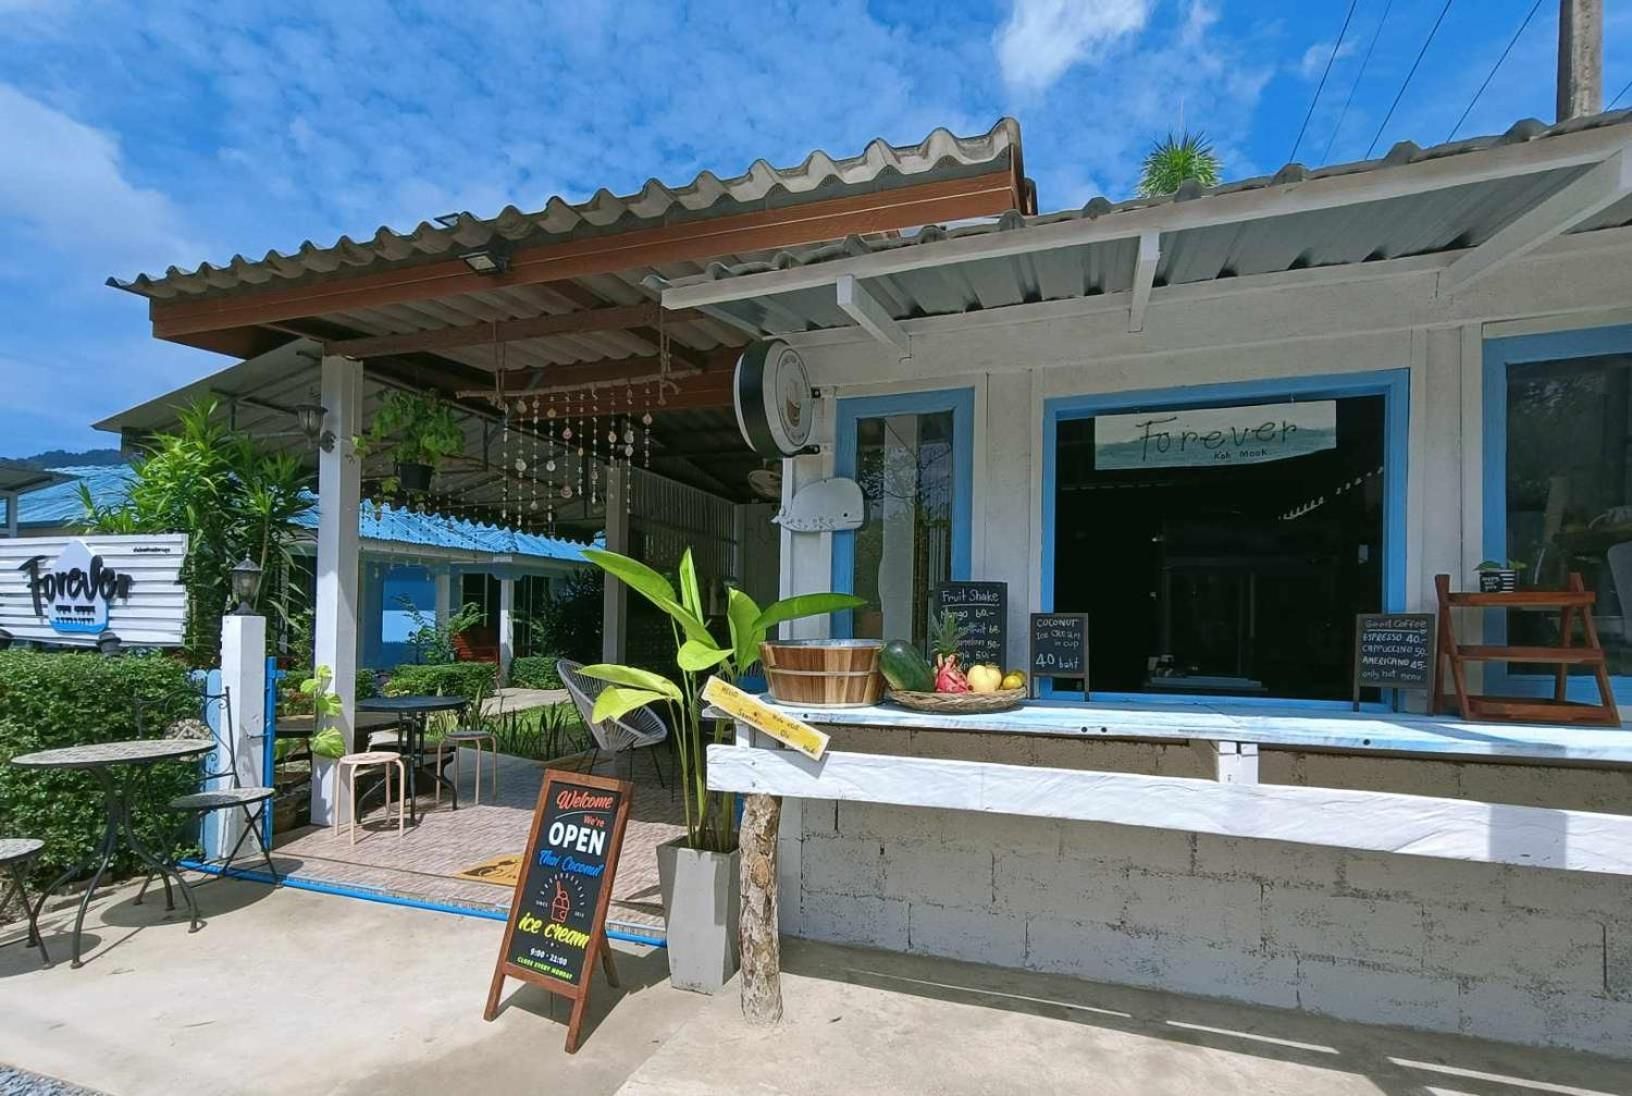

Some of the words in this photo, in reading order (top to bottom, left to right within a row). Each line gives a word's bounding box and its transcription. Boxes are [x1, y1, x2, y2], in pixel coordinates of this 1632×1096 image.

[1136, 416, 1298, 462] Forever
[18, 554, 135, 617] Forever
[941, 588, 966, 602] Fruit
[969, 589, 1000, 601] Shake
[1036, 618, 1079, 628] COCONUT
[1363, 633, 1402, 641] ESPRESSO
[1036, 653, 1055, 668] 40
[1059, 655, 1080, 670] baht
[1362, 656, 1410, 667] AMERICANO
[556, 790, 613, 809] Welcome
[583, 814, 605, 828] We're
[548, 821, 606, 856] OPEN
[561, 855, 605, 878] Coconut
[518, 911, 543, 935] ice
[543, 923, 591, 949] cream
